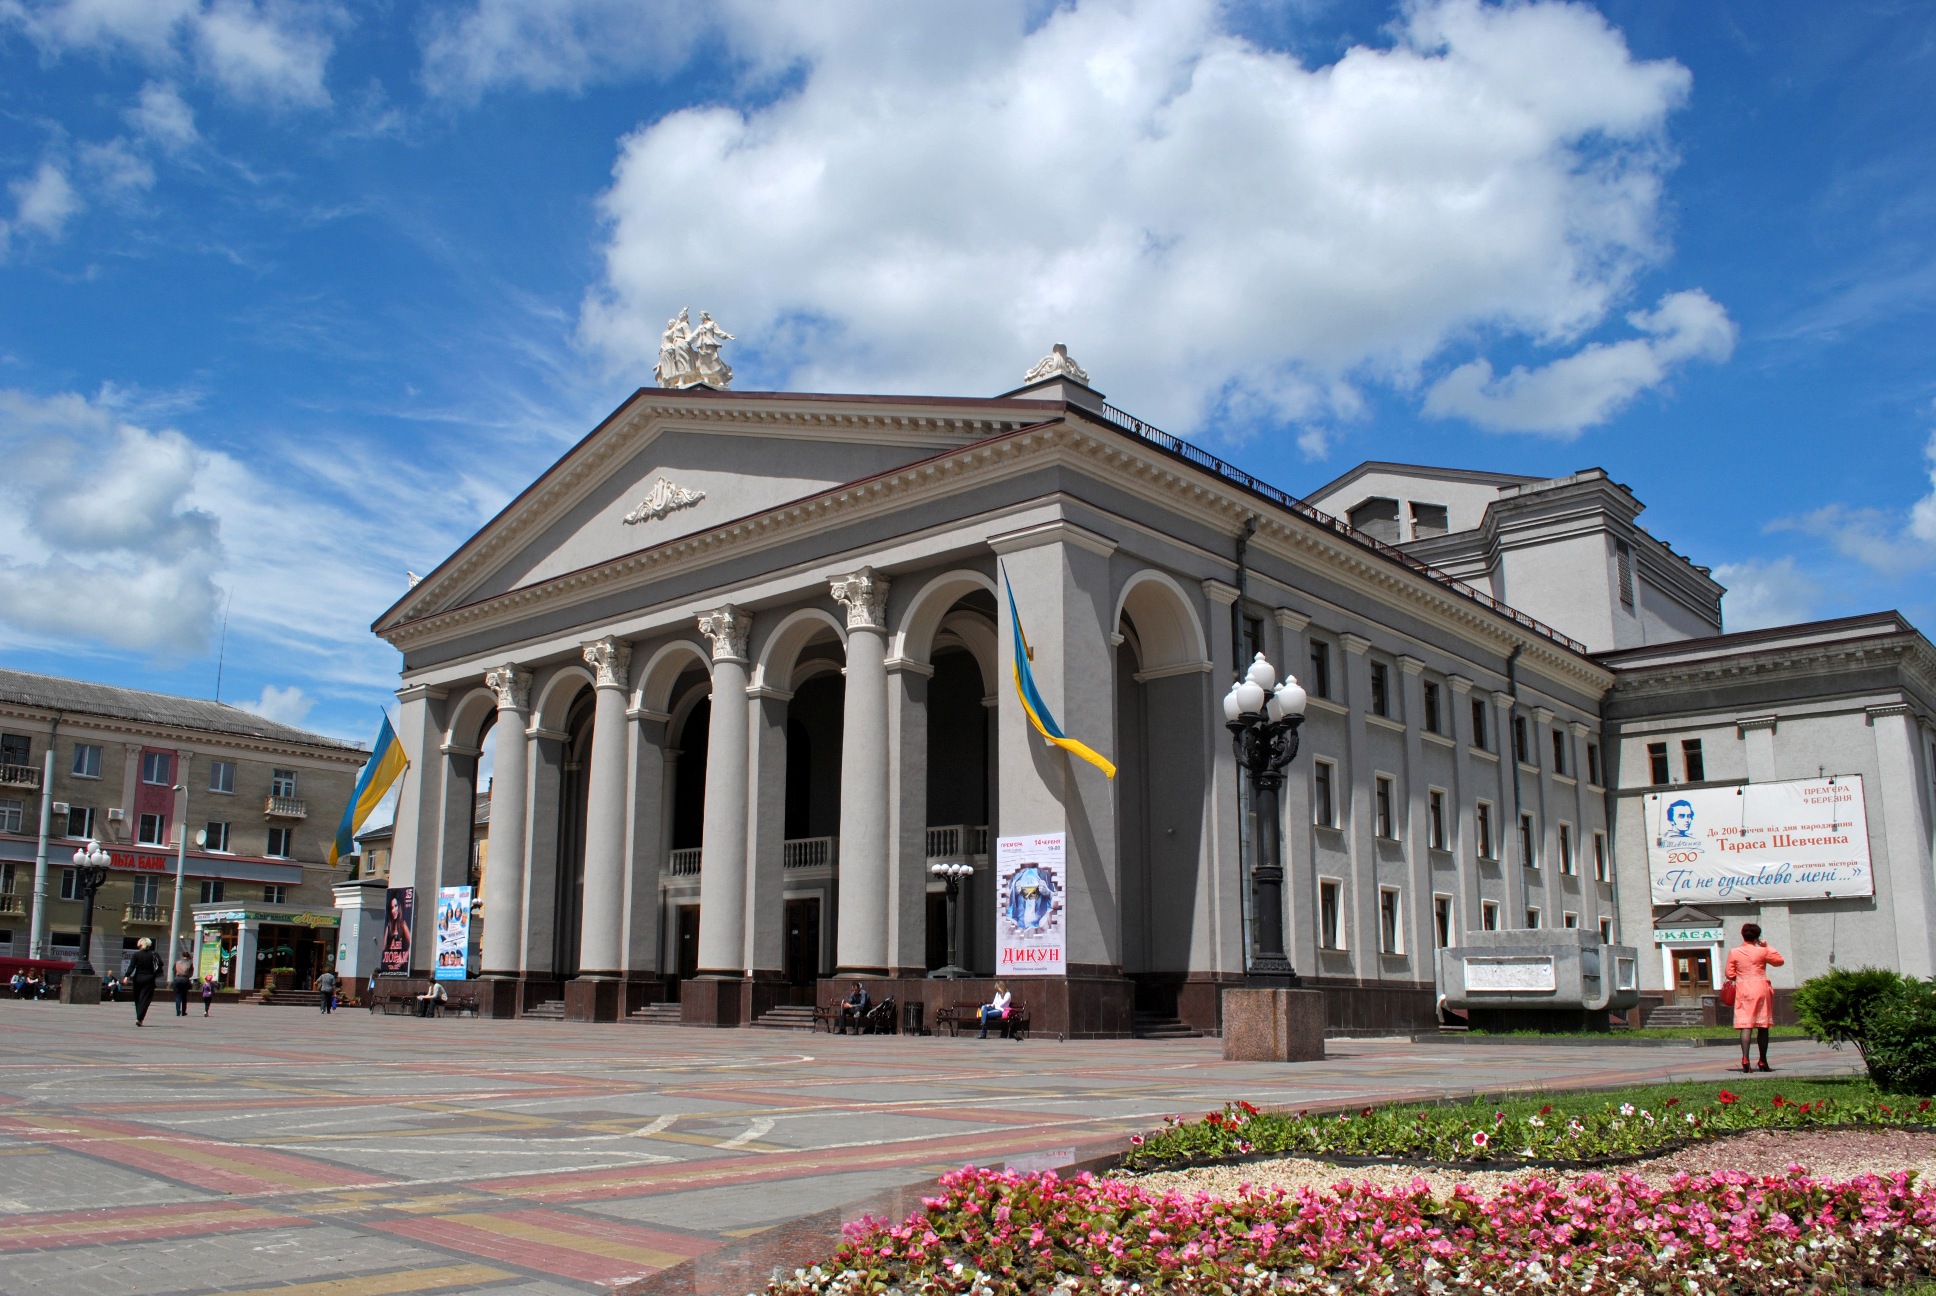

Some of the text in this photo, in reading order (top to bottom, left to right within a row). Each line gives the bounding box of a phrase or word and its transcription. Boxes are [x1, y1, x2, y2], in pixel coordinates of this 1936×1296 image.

[1804, 785, 1850, 796] ПРЕМ'ЄРА
[1811, 794, 1853, 805] БЕРЕЗНЯ
[1706, 828, 1719, 838] До
[1767, 824, 1780, 833] від
[1782, 825, 1798, 833] дня
[1716, 834, 1849, 854] Тараса Шевченка
[137, 855, 166, 870] БАНК
[1667, 851, 1698, 864] 200
[1792, 860, 1859, 870] поетична містерія
[1695, 876, 1713, 889] не
[1717, 862, 1793, 897] однаково
[1664, 931, 1713, 940] КАСА
